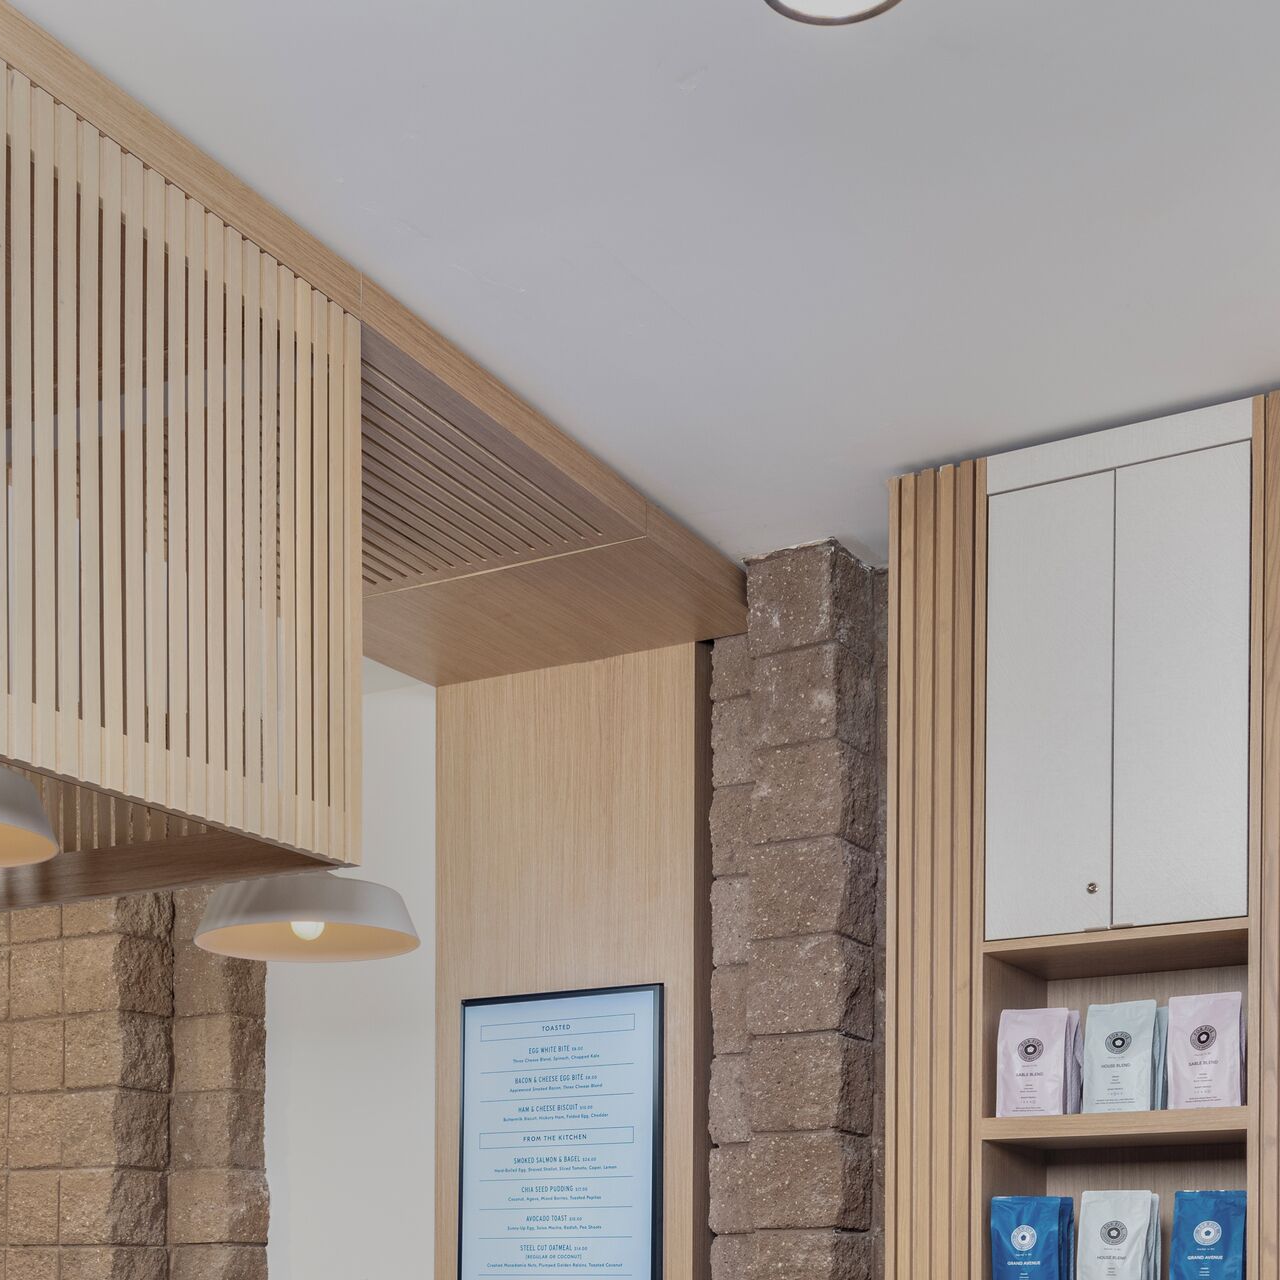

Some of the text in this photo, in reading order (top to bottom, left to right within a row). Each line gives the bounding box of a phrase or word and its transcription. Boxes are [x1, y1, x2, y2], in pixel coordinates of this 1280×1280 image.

[542, 1024, 571, 1032] TOASTED
[528, 1047, 539, 1055] EGG
[515, 1073, 584, 1085] BACON CHEESE EGG BITE
[558, 1134, 587, 1142] KITCHEN
[536, 1156, 557, 1164] SALMON
[563, 1155, 581, 1163] BAGEL
